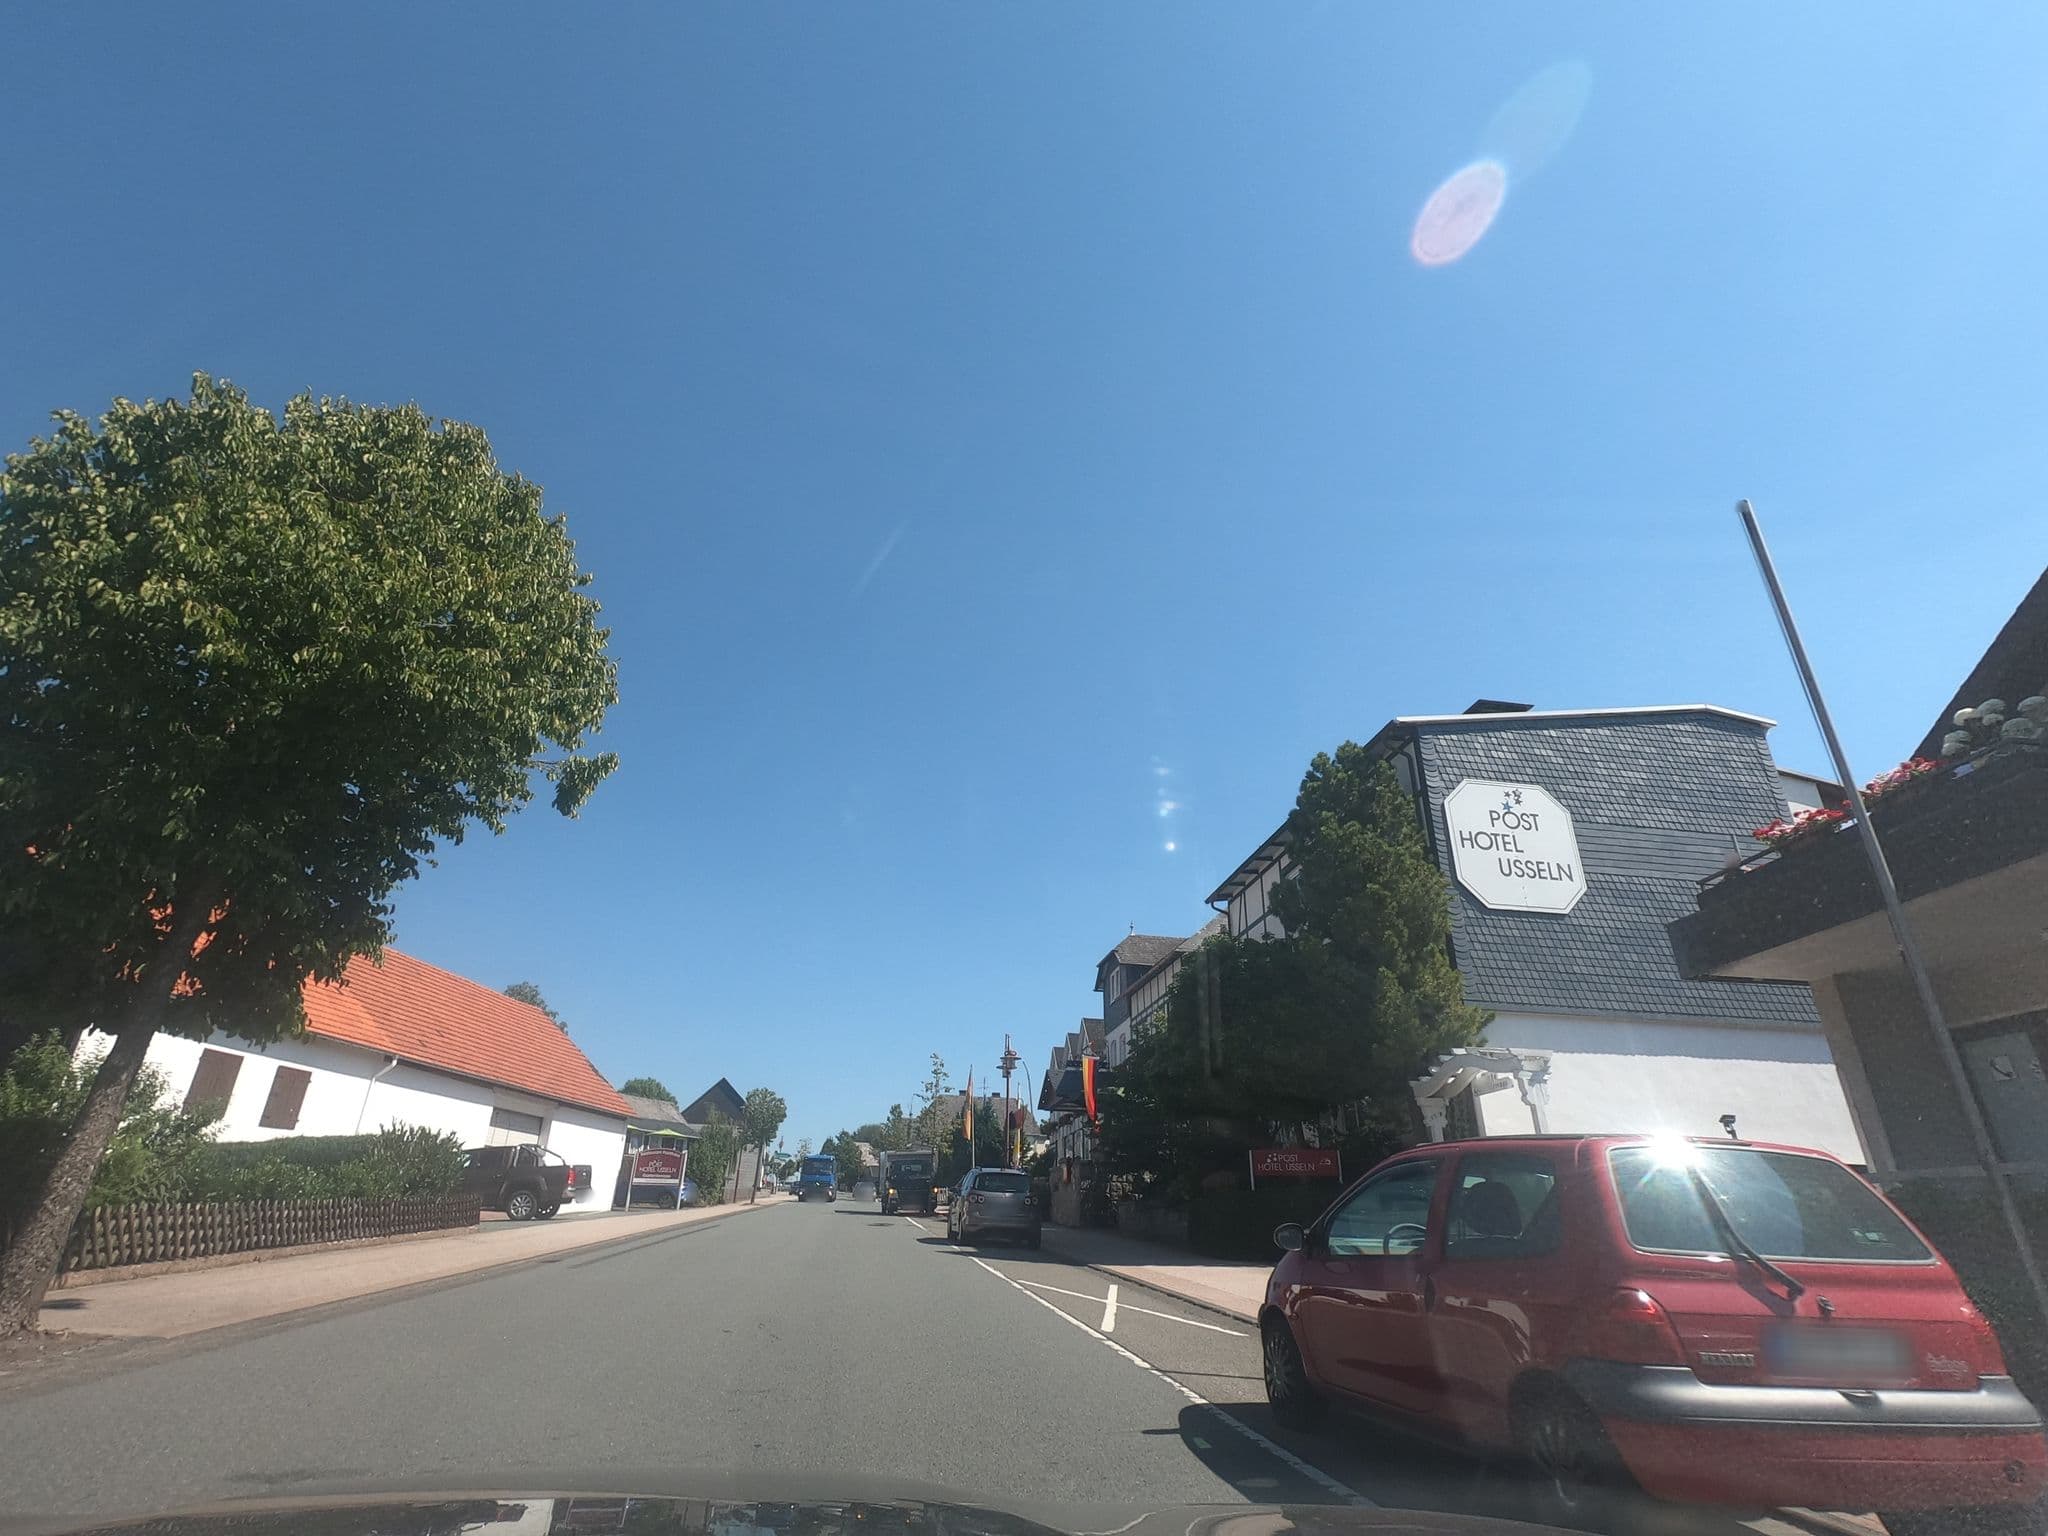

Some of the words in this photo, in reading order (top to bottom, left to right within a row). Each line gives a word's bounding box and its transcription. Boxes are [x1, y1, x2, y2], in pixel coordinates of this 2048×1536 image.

[1489, 810, 1539, 832] POST
[1459, 830, 1524, 853] HOTEL
[1498, 857, 1574, 882] USSELN
[1258, 1163, 1282, 1171] HOTEL
[1285, 1163, 1315, 1171] USSELN
[1278, 1154, 1298, 1162] POST
